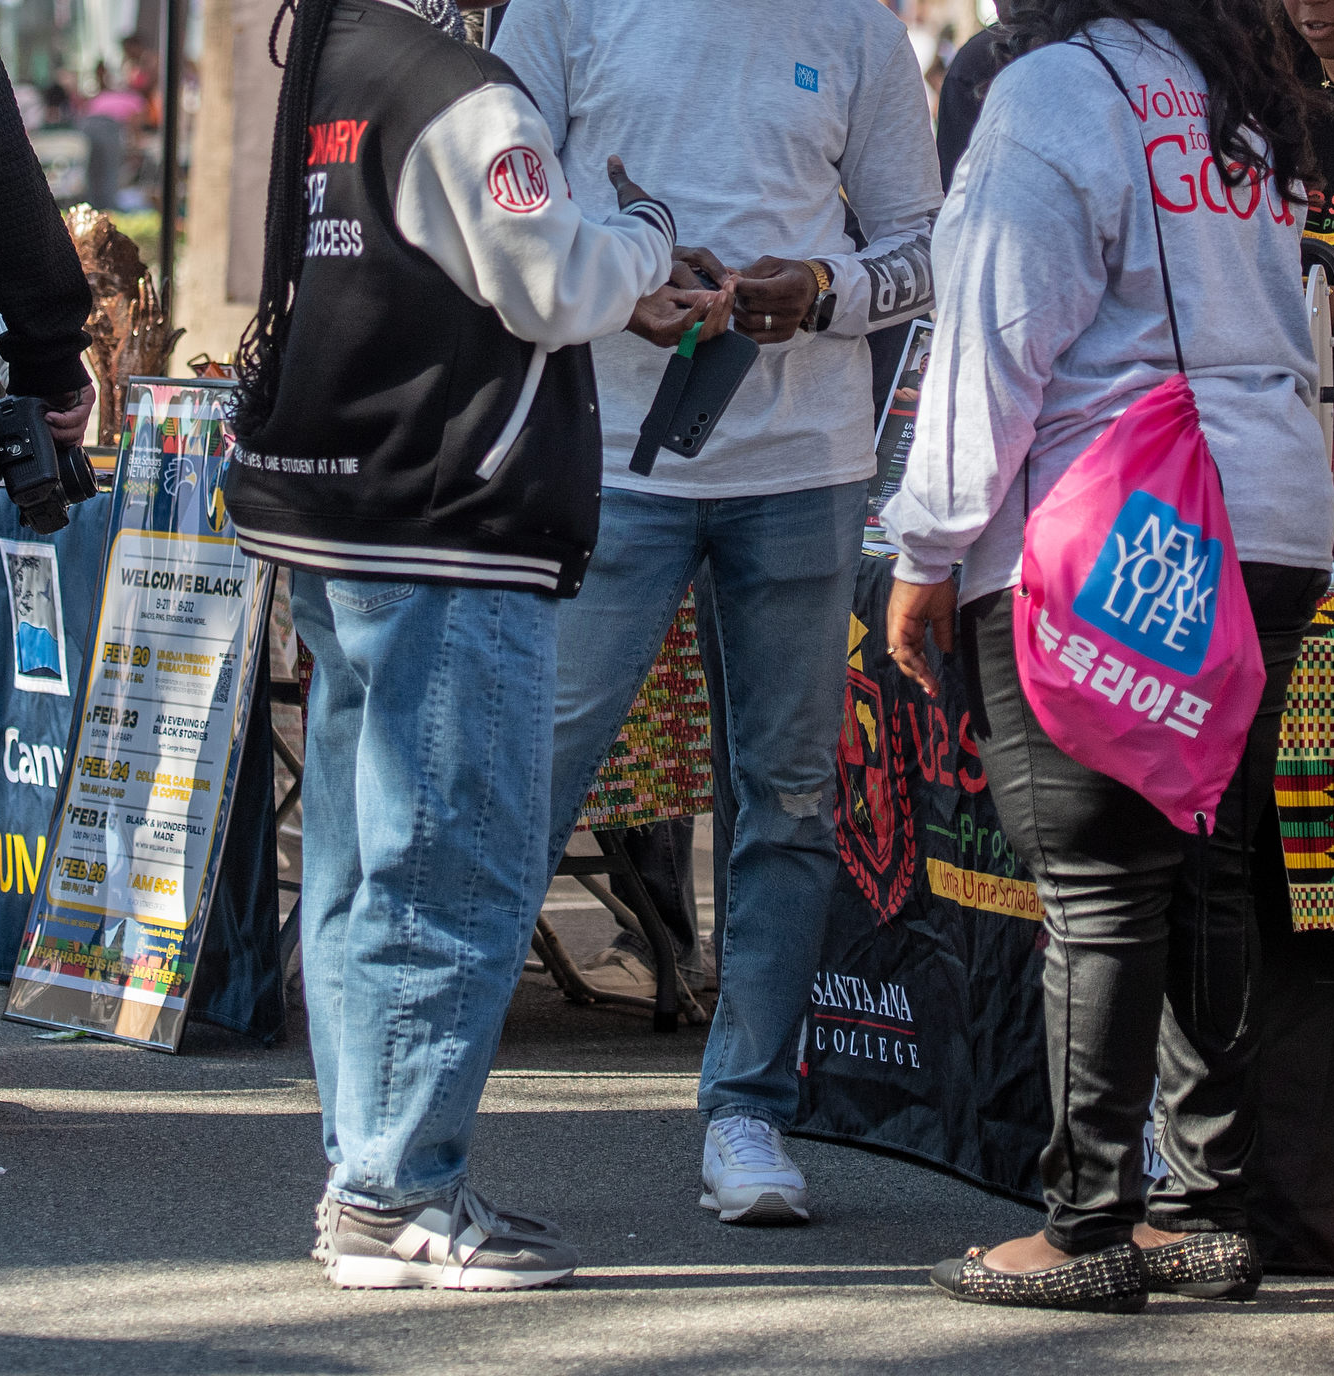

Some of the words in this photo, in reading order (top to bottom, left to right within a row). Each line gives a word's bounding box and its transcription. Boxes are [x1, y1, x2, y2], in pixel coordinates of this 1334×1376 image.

[281, 456, 315, 474] STUDENT
[318, 458, 328, 474] AT
[330, 459, 337, 474] A
[338, 458, 359, 474] TIME
[1132, 513, 1209, 576] NEW
[121, 568, 193, 593] WELCOME
[194, 575, 245, 598] BLACK
[1113, 532, 1214, 624] YORK
[1102, 575, 1190, 652] LIFE
[132, 645, 151, 668] 20
[121, 710, 139, 729] 23
[152, 725, 178, 737] BLACK
[178, 728, 209, 741] STORIES
[81, 756, 110, 779] FEB
[110, 760, 130, 782] 24
[70, 806, 99, 827] FEB
[126, 815, 149, 828] BLACK
[156, 820, 207, 837] WONDERFULLY
[153, 830, 175, 842] MADE
[59, 856, 88, 880] FEB
[88, 861, 107, 883] 26
[154, 877, 178, 896] SCC
[60, 950, 106, 970] HAPPENS
[811, 972, 875, 1014] SANTA
[879, 981, 913, 1022] ANA
[815, 1026, 921, 1069] COLLEGE
